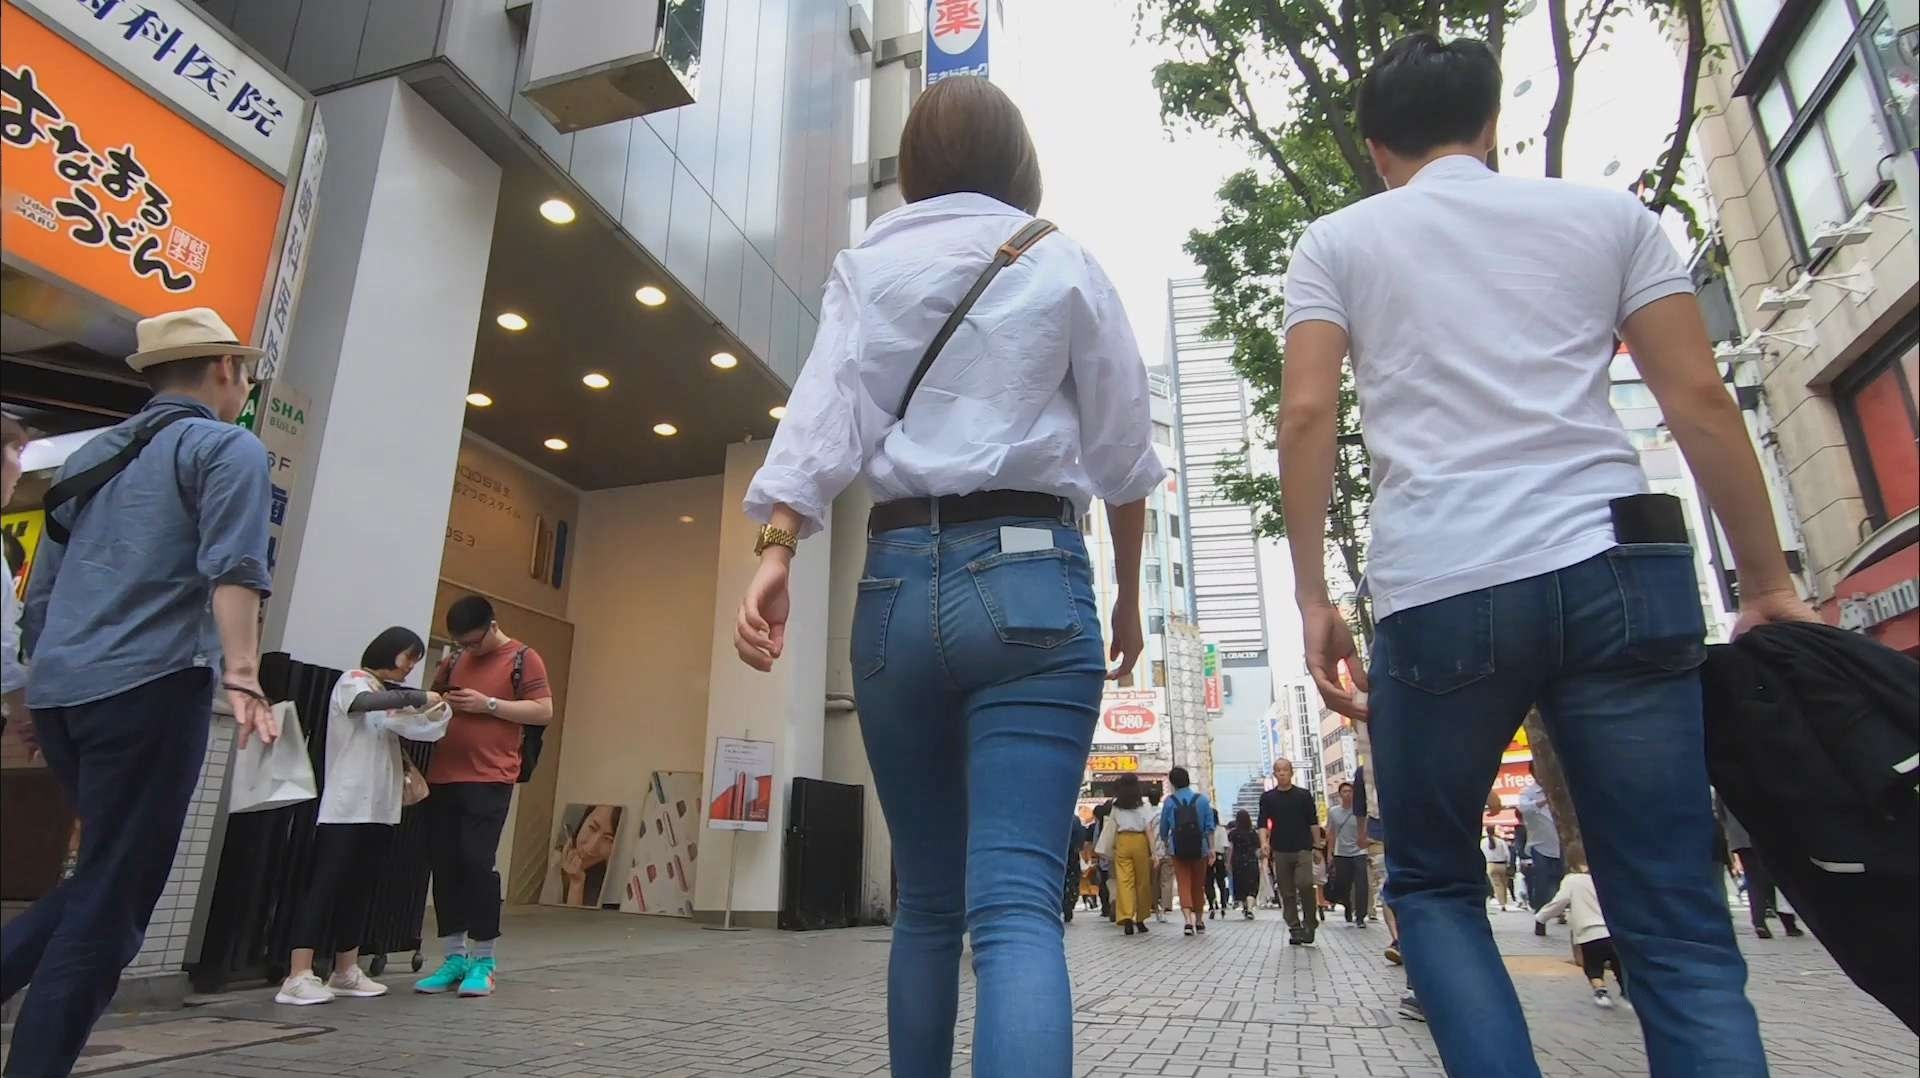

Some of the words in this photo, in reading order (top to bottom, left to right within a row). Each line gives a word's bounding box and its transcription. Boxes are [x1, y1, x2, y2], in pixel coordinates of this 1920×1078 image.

[56, 187, 192, 290] うどん
[271, 397, 305, 425] SHA
